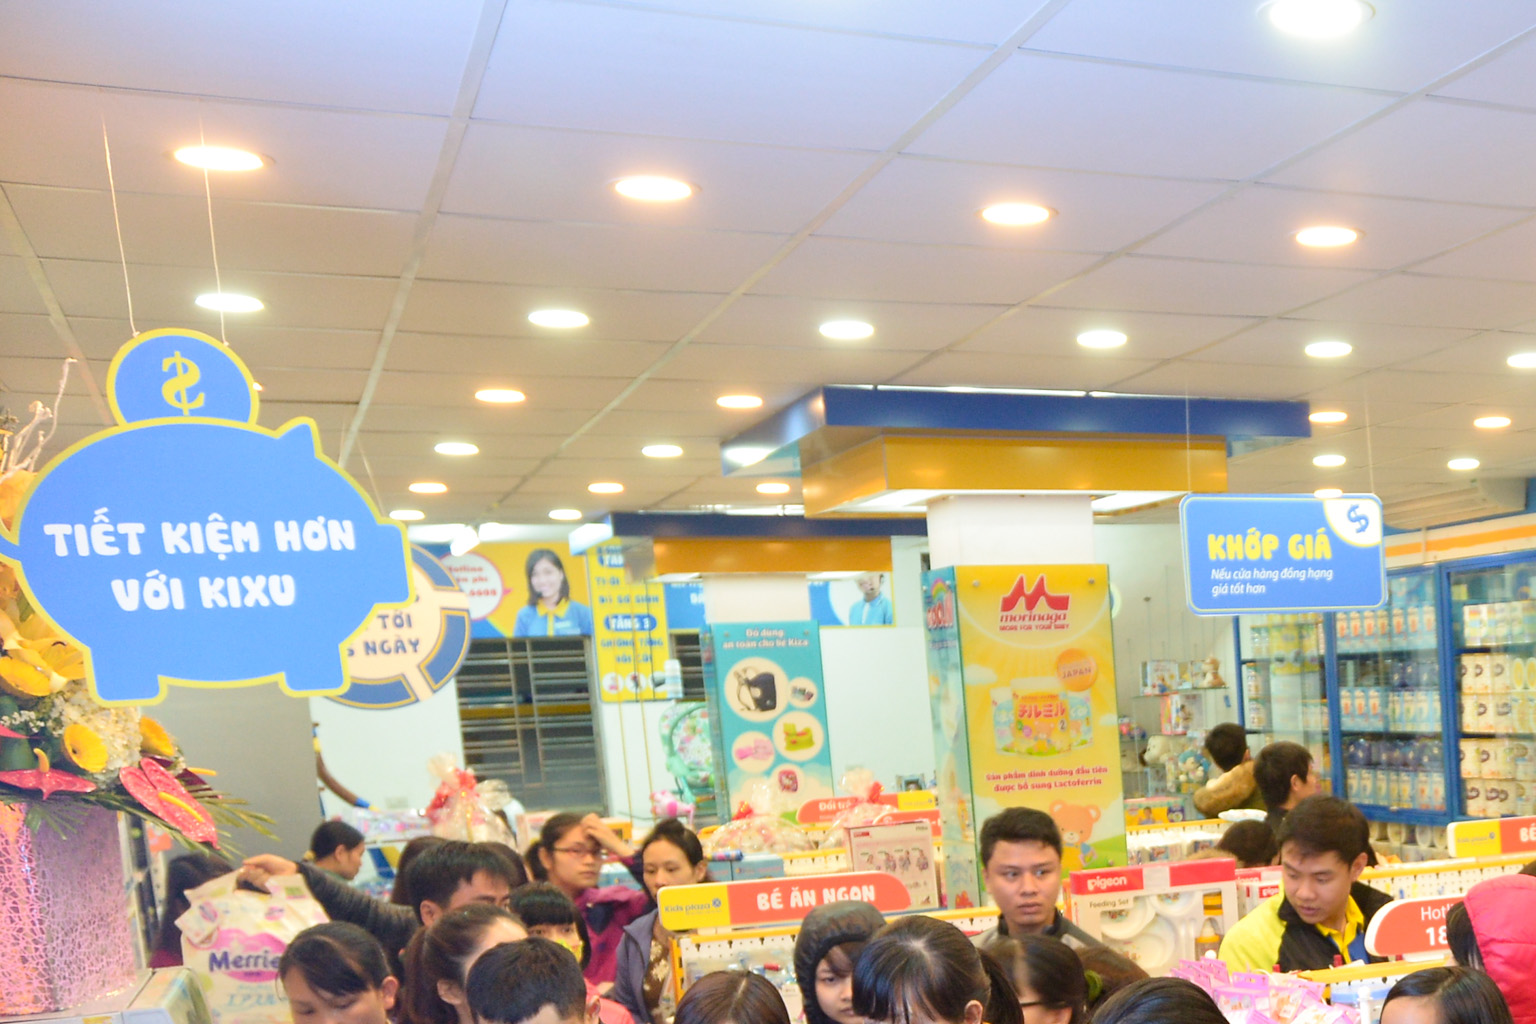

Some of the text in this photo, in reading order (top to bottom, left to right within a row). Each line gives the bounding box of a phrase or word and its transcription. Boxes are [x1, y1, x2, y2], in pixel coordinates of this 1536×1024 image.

[43, 507, 355, 561] TIẾT KIỆM HƠN
[1207, 527, 1332, 560] KHỚP GIÁ
[1211, 567, 1333, 581] Nếu cửa hàng đồng hạng
[111, 569, 295, 612] VỚI KIXU
[1211, 582, 1266, 597] giá tốt hơn
[1000, 612, 1067, 624] morinaga
[363, 634, 420, 655] NGÀY
[1062, 667, 1092, 679] JAPAN
[1054, 777, 1102, 788] Lactoferrin
[1519, 825, 1536, 842] BÉ
[1087, 874, 1127, 891] pigeon
[756, 883, 876, 911] BÉ ĂN NGON
[1089, 898, 1130, 910] Feeding Set
[208, 949, 281, 972] Merrie
